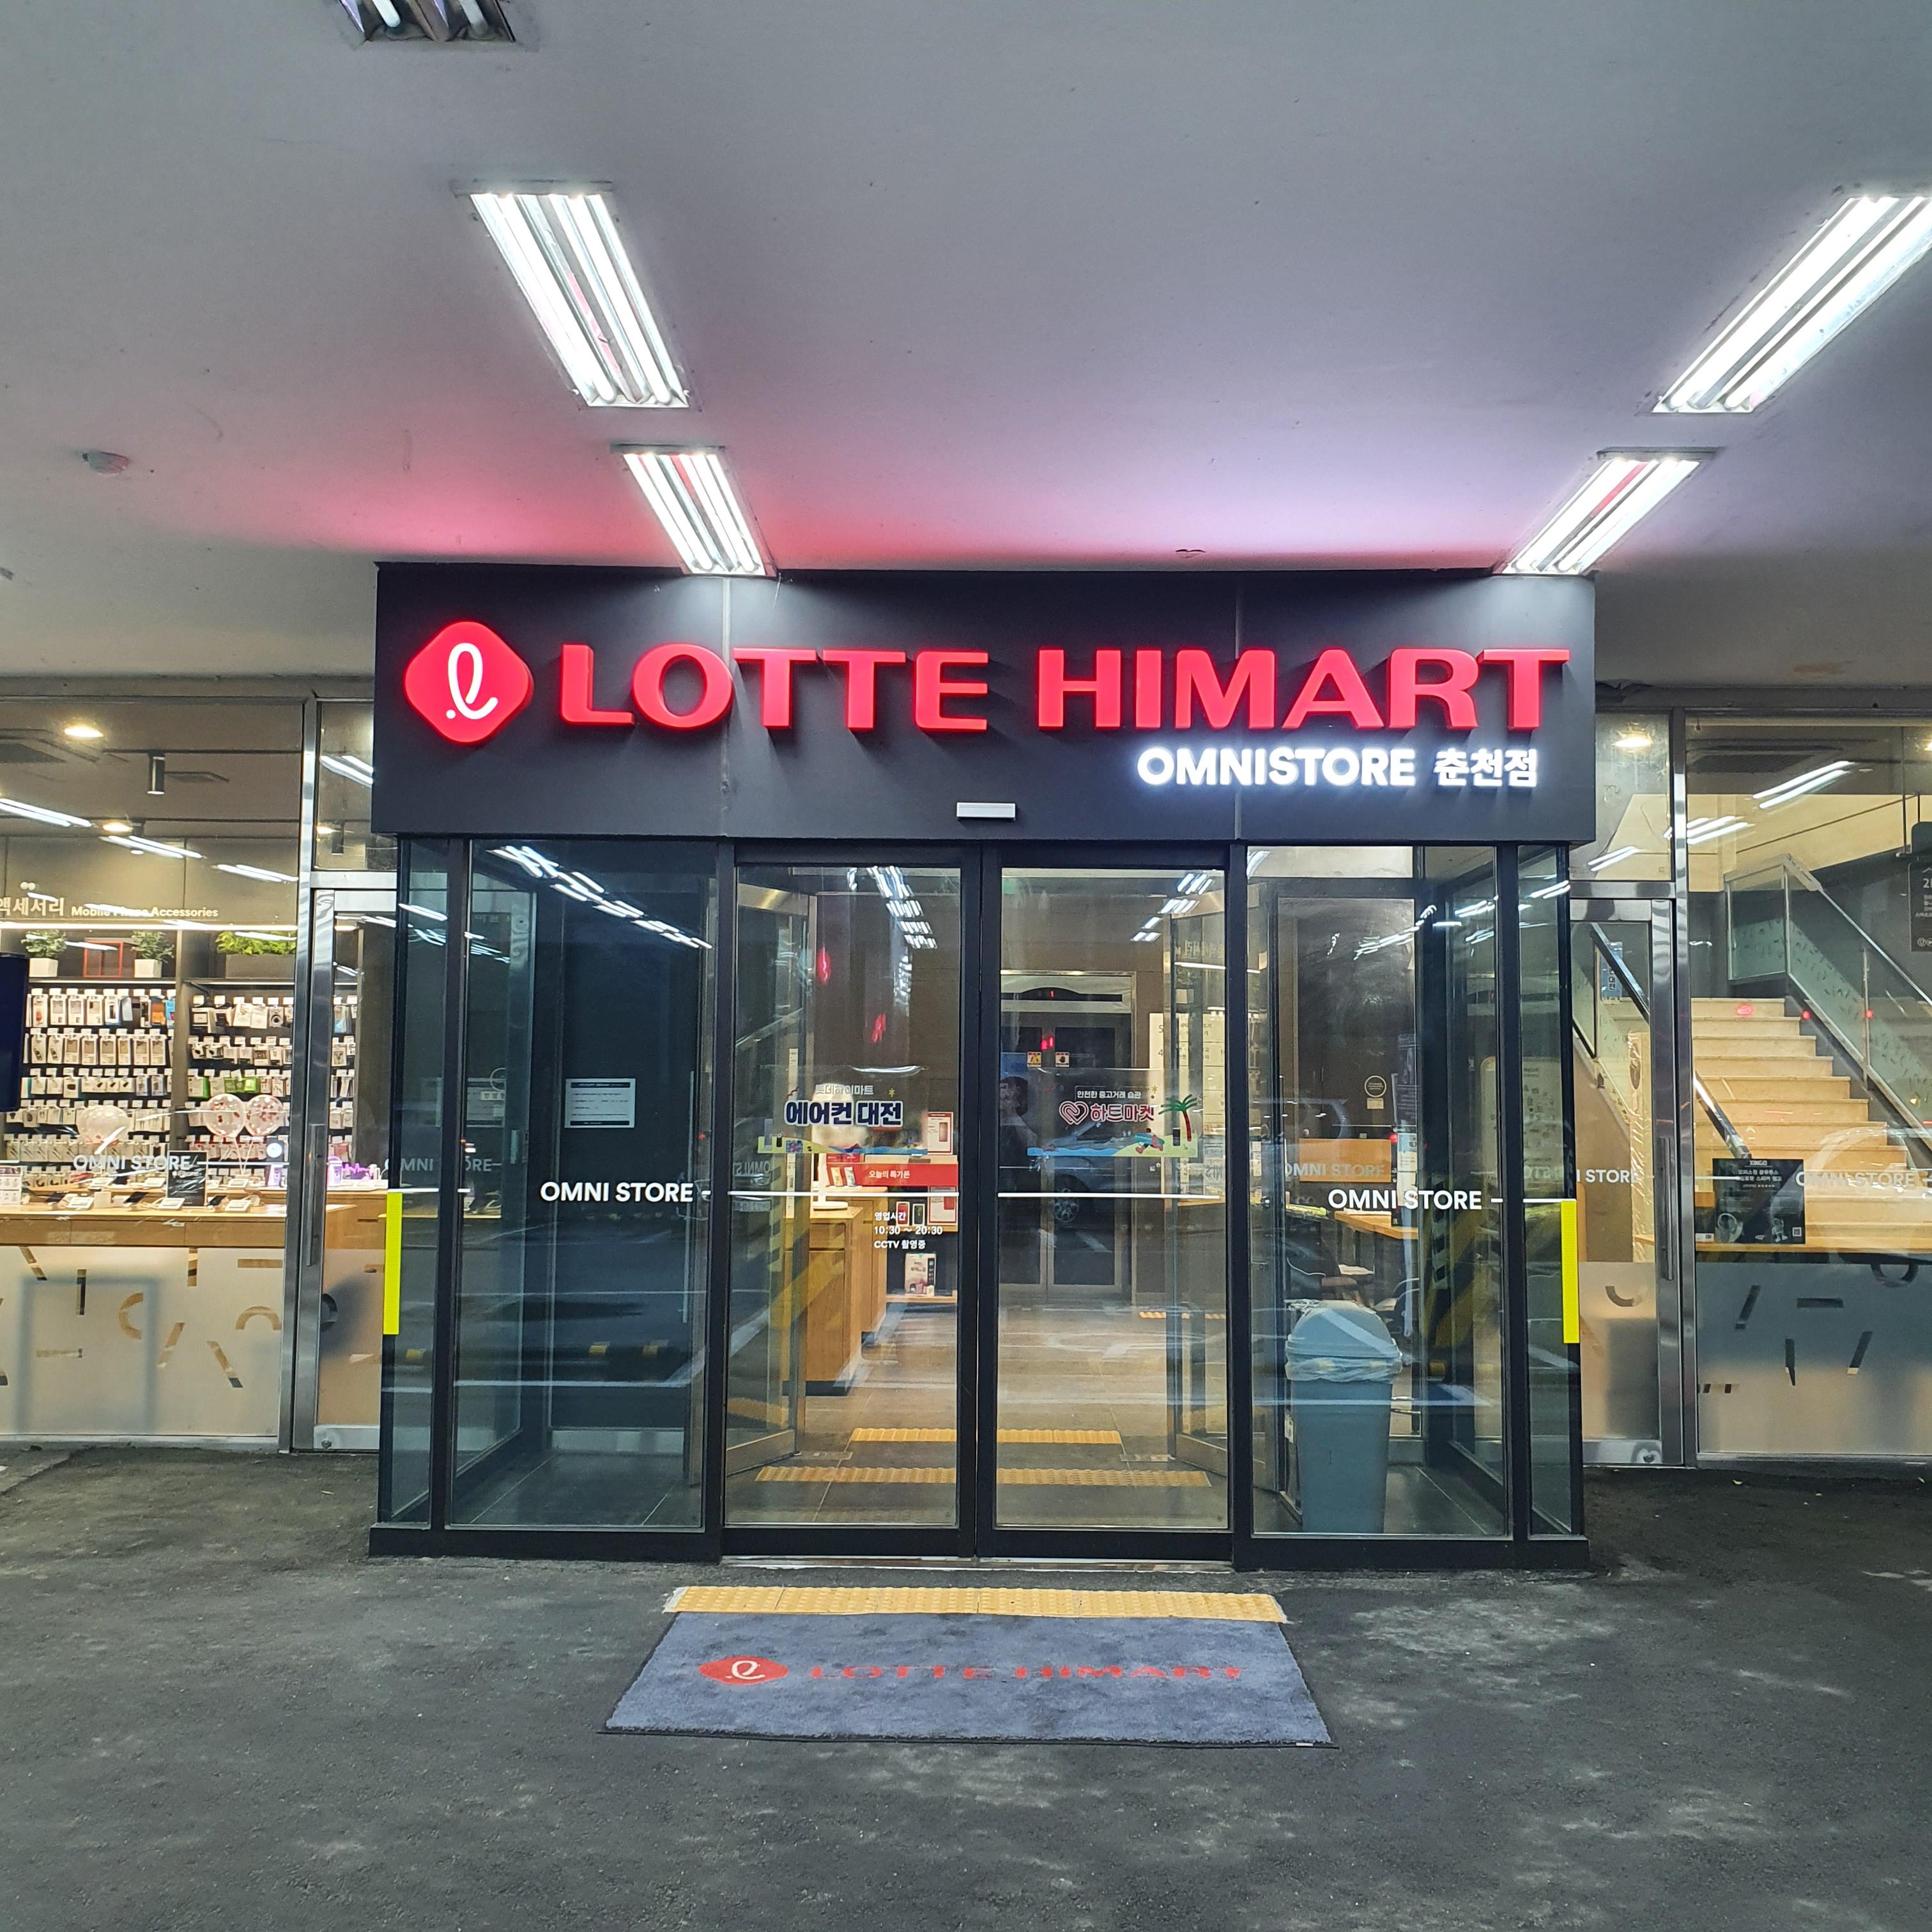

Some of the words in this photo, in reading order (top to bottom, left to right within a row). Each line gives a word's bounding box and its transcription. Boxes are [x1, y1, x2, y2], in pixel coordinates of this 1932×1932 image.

[560, 642, 990, 733] LOTTE
[1036, 648, 1570, 730] HIMART
[1137, 747, 1416, 786] OMNISTORE
[1433, 747, 1539, 788] 춘천점
[151, 906, 219, 917] Accessories
[785, 1100, 854, 1126] 에어컨
[856, 1100, 903, 1127] 대전
[1090, 1102, 1154, 1122] 하트마켓
[73, 1154, 126, 1170] OMNI
[130, 1154, 191, 1171] STORE
[540, 1181, 610, 1202] OMNI
[615, 1182, 694, 1203] STORE
[1328, 1188, 1397, 1209] OMNI
[1404, 1190, 1483, 1211] STORE
[873, 1211, 907, 1222] 영업시간
[874, 1225, 901, 1235] 10:30
[915, 1225, 943, 1235] 20:30
[873, 1240, 900, 1248] CCTV
[901, 1239, 926, 1250] 촬영중
[810, 1664, 994, 1679] LOTTE
[1015, 1664, 1246, 1679] HIMART
